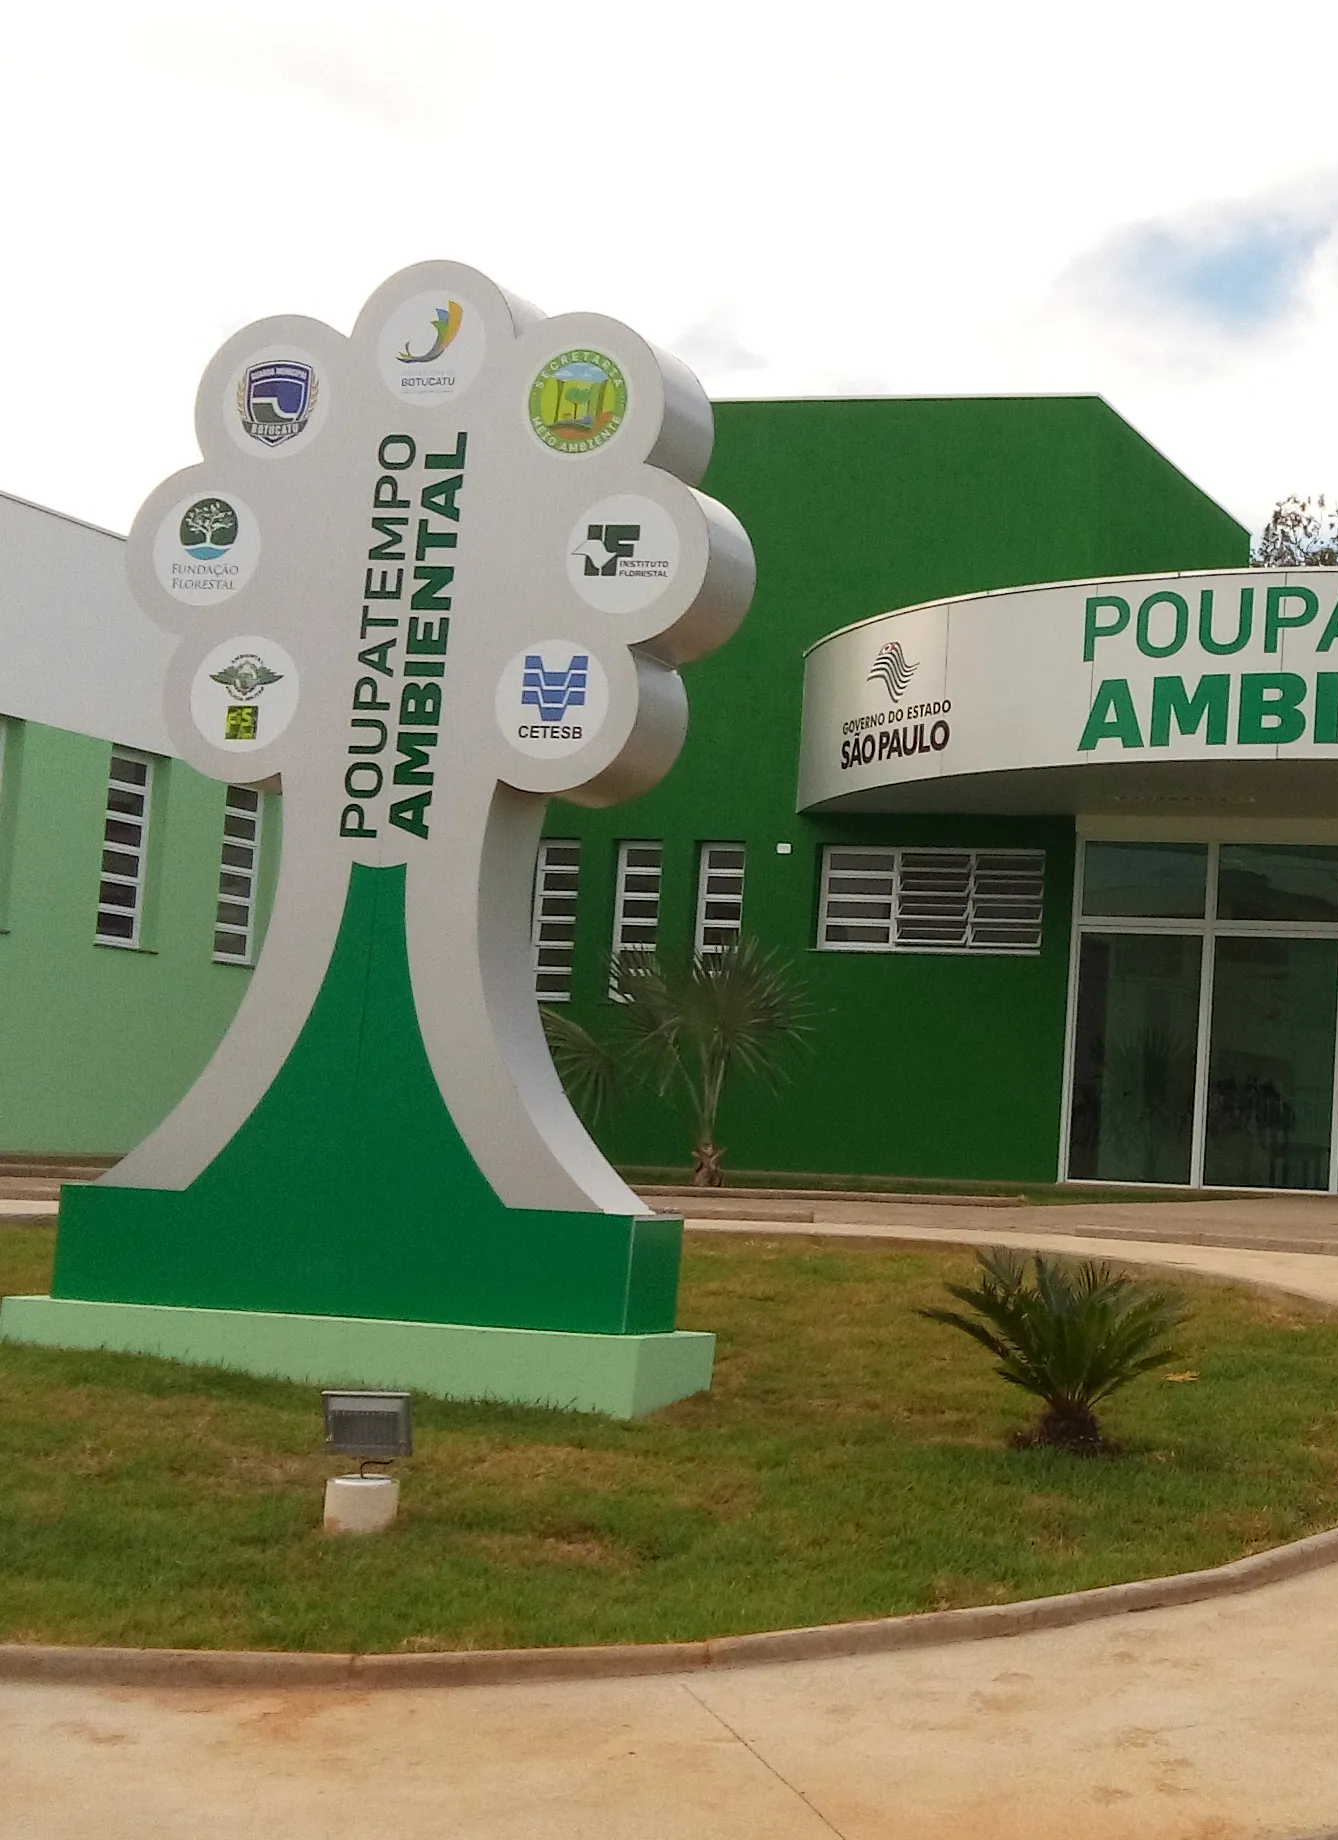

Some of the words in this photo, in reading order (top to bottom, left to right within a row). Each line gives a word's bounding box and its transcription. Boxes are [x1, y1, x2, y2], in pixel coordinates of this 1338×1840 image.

[534, 351, 623, 390] SECRETARIA
[401, 376, 456, 387] BOTUCATU
[250, 422, 299, 435] BOTUCATU
[531, 415, 558, 447] MEIO
[560, 415, 622, 453] AMBIENTE
[171, 563, 239, 577] FUNDAÇÃO
[619, 560, 669, 568] INSTITUTO
[619, 569, 669, 578] FLORESTAL
[171, 577, 236, 590] FLORESTAL
[339, 434, 417, 839] POUPATEMPO
[388, 431, 468, 840] AMBIENTAL
[842, 712, 886, 736] GOVERNO
[888, 708, 904, 724] DO
[907, 699, 952, 720] ESTADO
[518, 725, 583, 739] CETESB
[841, 732, 876, 770] SÃO
[878, 719, 951, 761] PAULO
